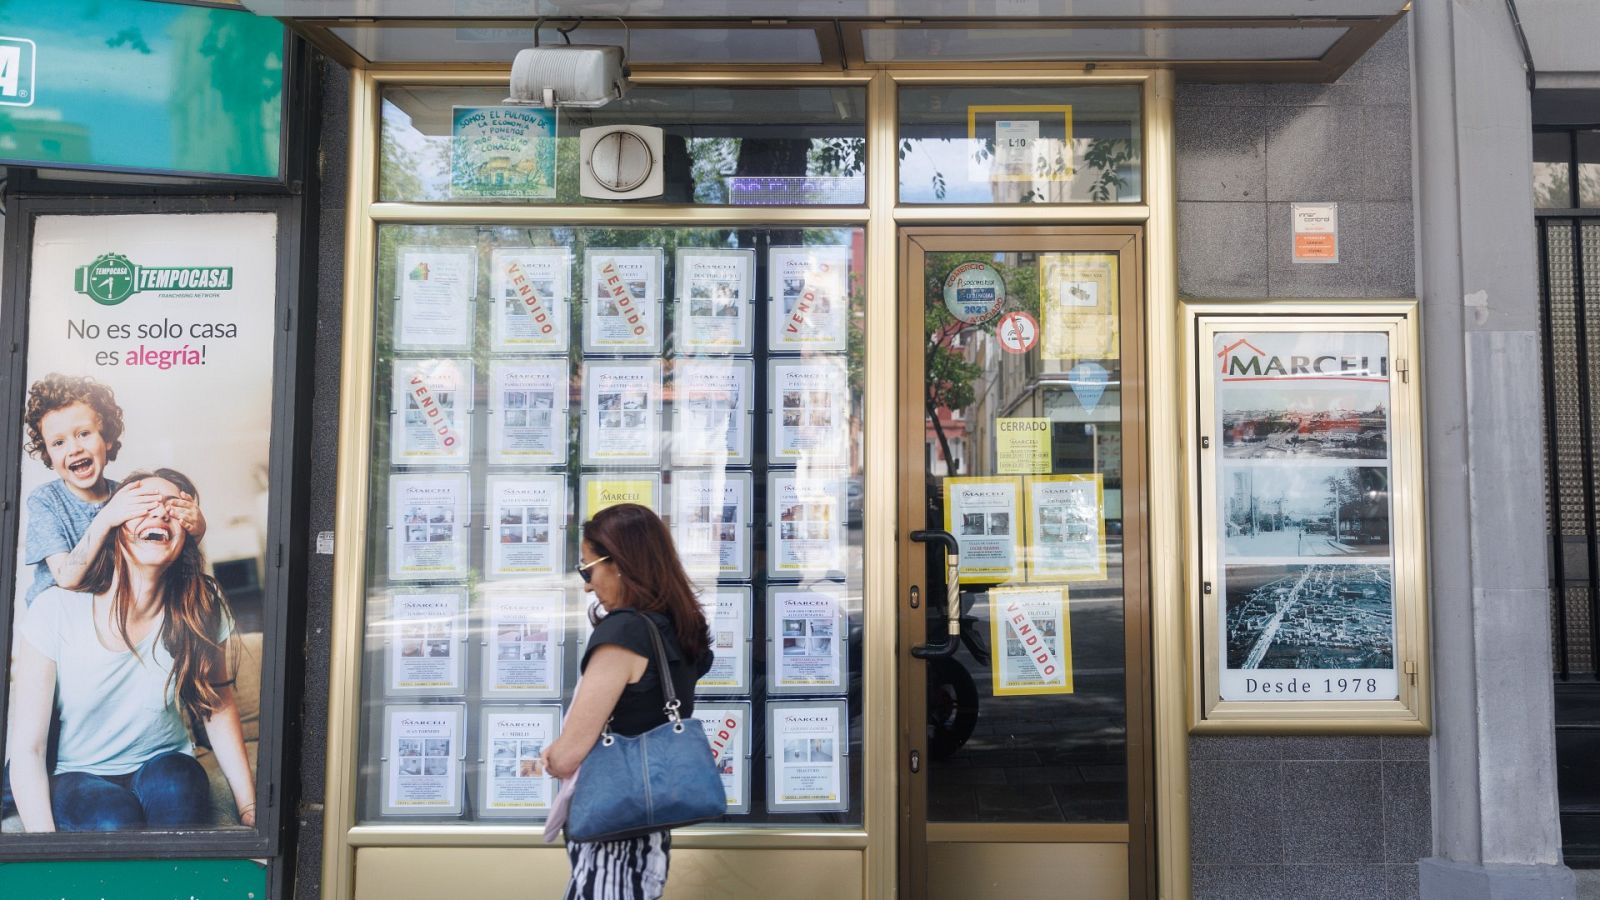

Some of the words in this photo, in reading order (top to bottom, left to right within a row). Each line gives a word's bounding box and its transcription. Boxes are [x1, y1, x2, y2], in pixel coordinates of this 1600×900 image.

[1008, 138, 1026, 147] L10
[95, 267, 128, 276] TEMPOCASA
[139, 269, 228, 288] TEMPOCASA
[507, 263, 553, 335] VENDIDO
[602, 263, 645, 336] VENDIDO
[67, 319, 100, 340] No
[107, 323, 131, 339] es
[138, 318, 183, 339] solo
[190, 323, 238, 339] casa
[95, 350, 119, 365] es
[125, 345, 206, 370] alegría!
[1229, 355, 1387, 377] MARCELI
[410, 376, 455, 447] VENDIDO
[1000, 421, 1047, 432] CERRADO
[602, 493, 640, 501] MARCELI
[1007, 601, 1056, 675] VENDIDO
[1246, 678, 1311, 693] Desde
[1324, 678, 1377, 693] 1978
